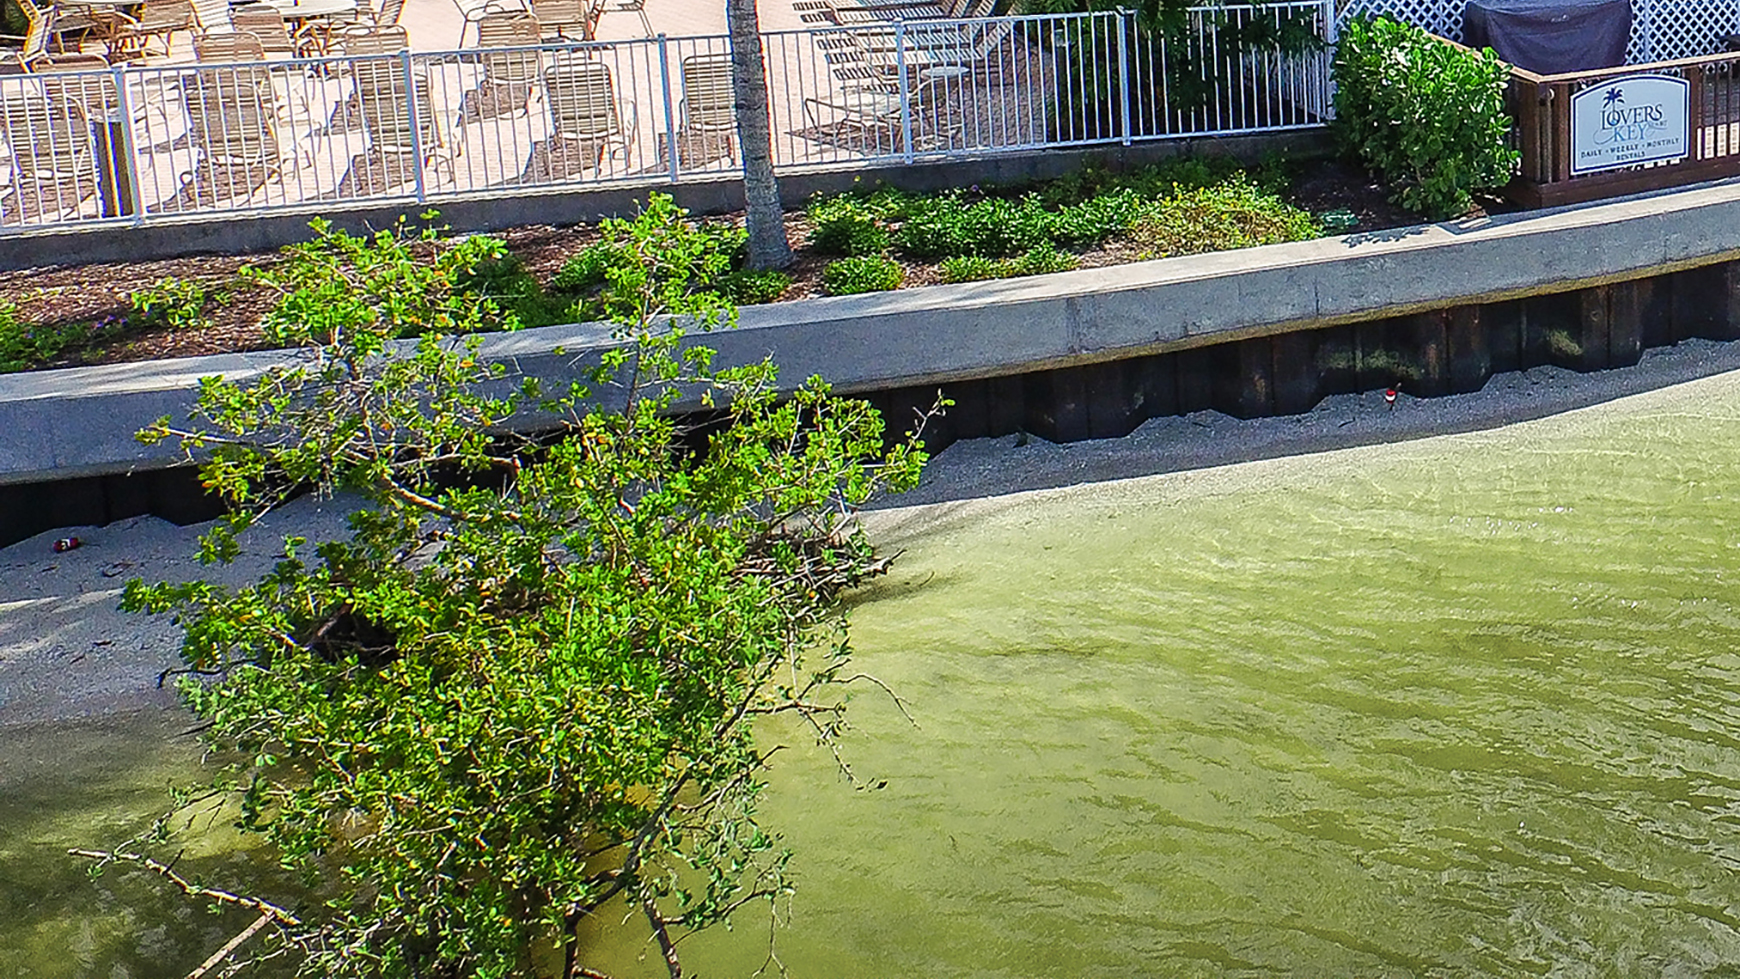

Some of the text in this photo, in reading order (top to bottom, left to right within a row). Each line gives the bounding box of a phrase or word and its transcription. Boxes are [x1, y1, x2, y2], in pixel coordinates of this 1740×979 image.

[1601, 103, 1662, 130] LOVERS
[1614, 123, 1647, 142] KEY
[1581, 138, 1679, 158] DAILY WEEKLY MONTHLY
[1616, 151, 1645, 161] RENTALS
